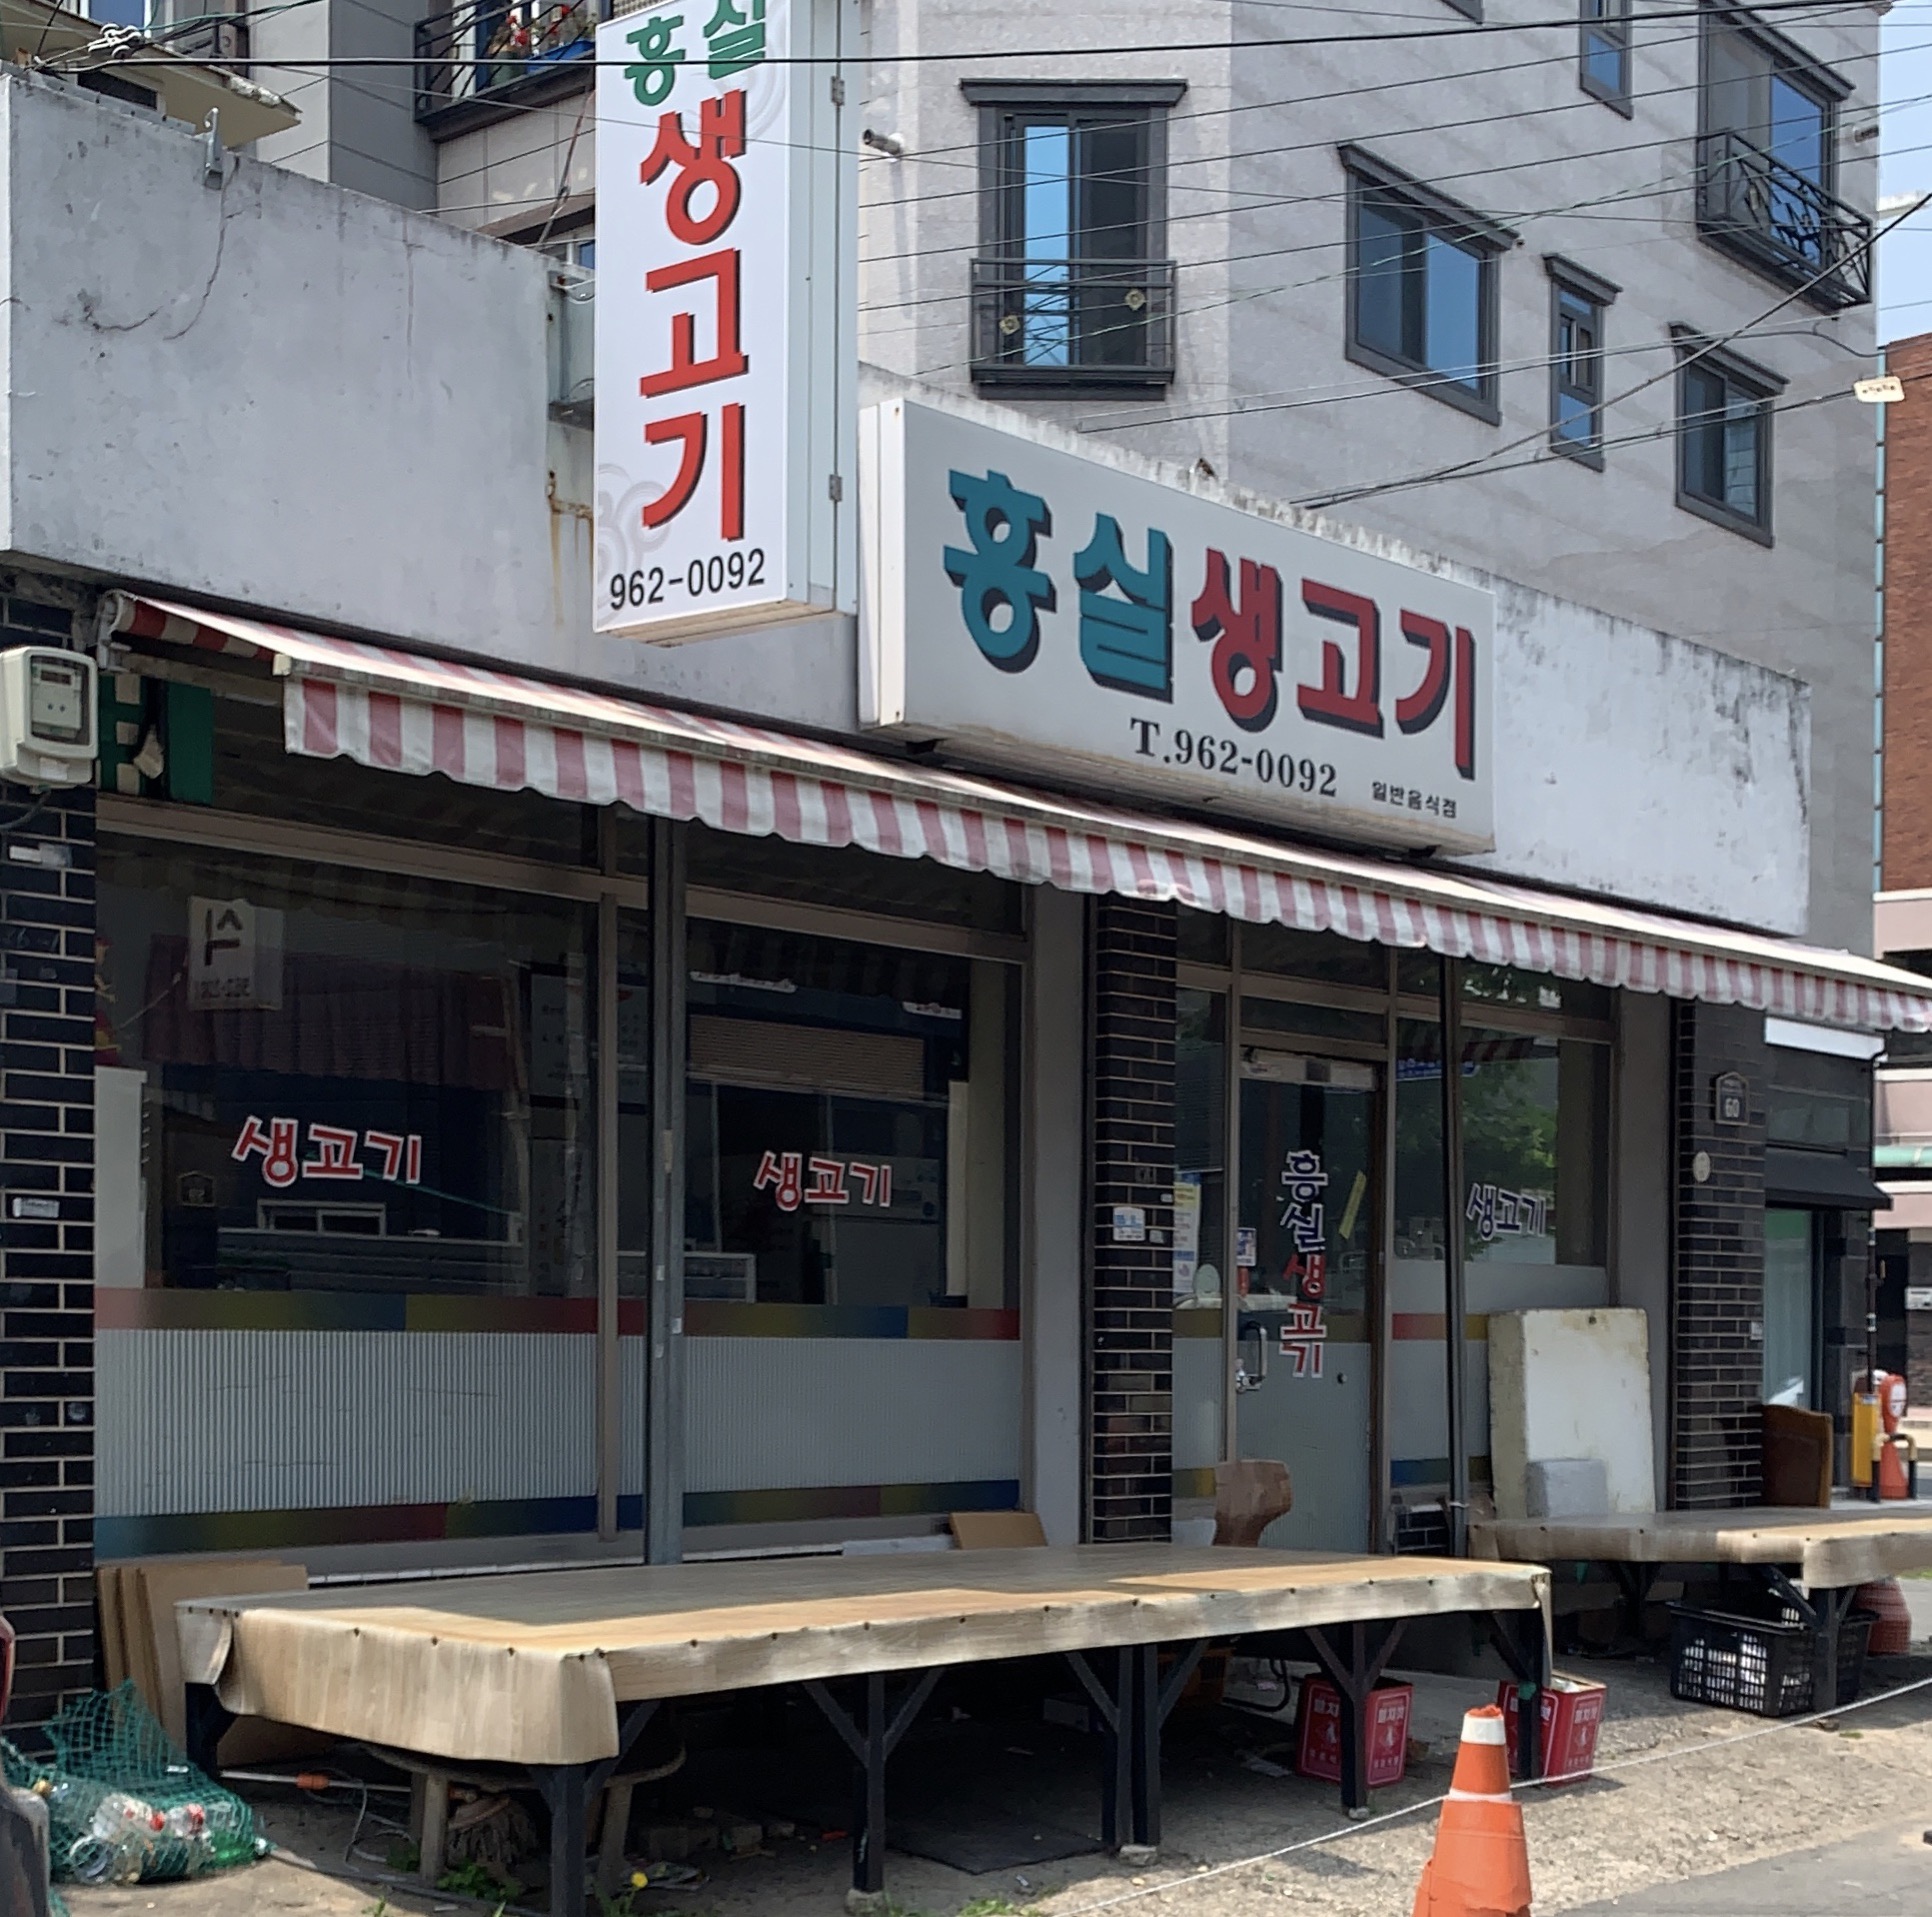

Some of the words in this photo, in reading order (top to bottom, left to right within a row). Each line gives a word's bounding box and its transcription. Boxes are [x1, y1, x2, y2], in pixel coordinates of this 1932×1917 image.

[640, 88, 749, 542] 생고기
[610, 547, 765, 611] 962-0092
[1191, 547, 1475, 780] 생고기
[1130, 717, 1337, 798] T.962-0092
[1372, 781, 1457, 819] 일반음식점
[231, 1115, 422, 1188] 생고기
[753, 1150, 892, 1212] 생고기
[1466, 1182, 1547, 1241] 생고기
